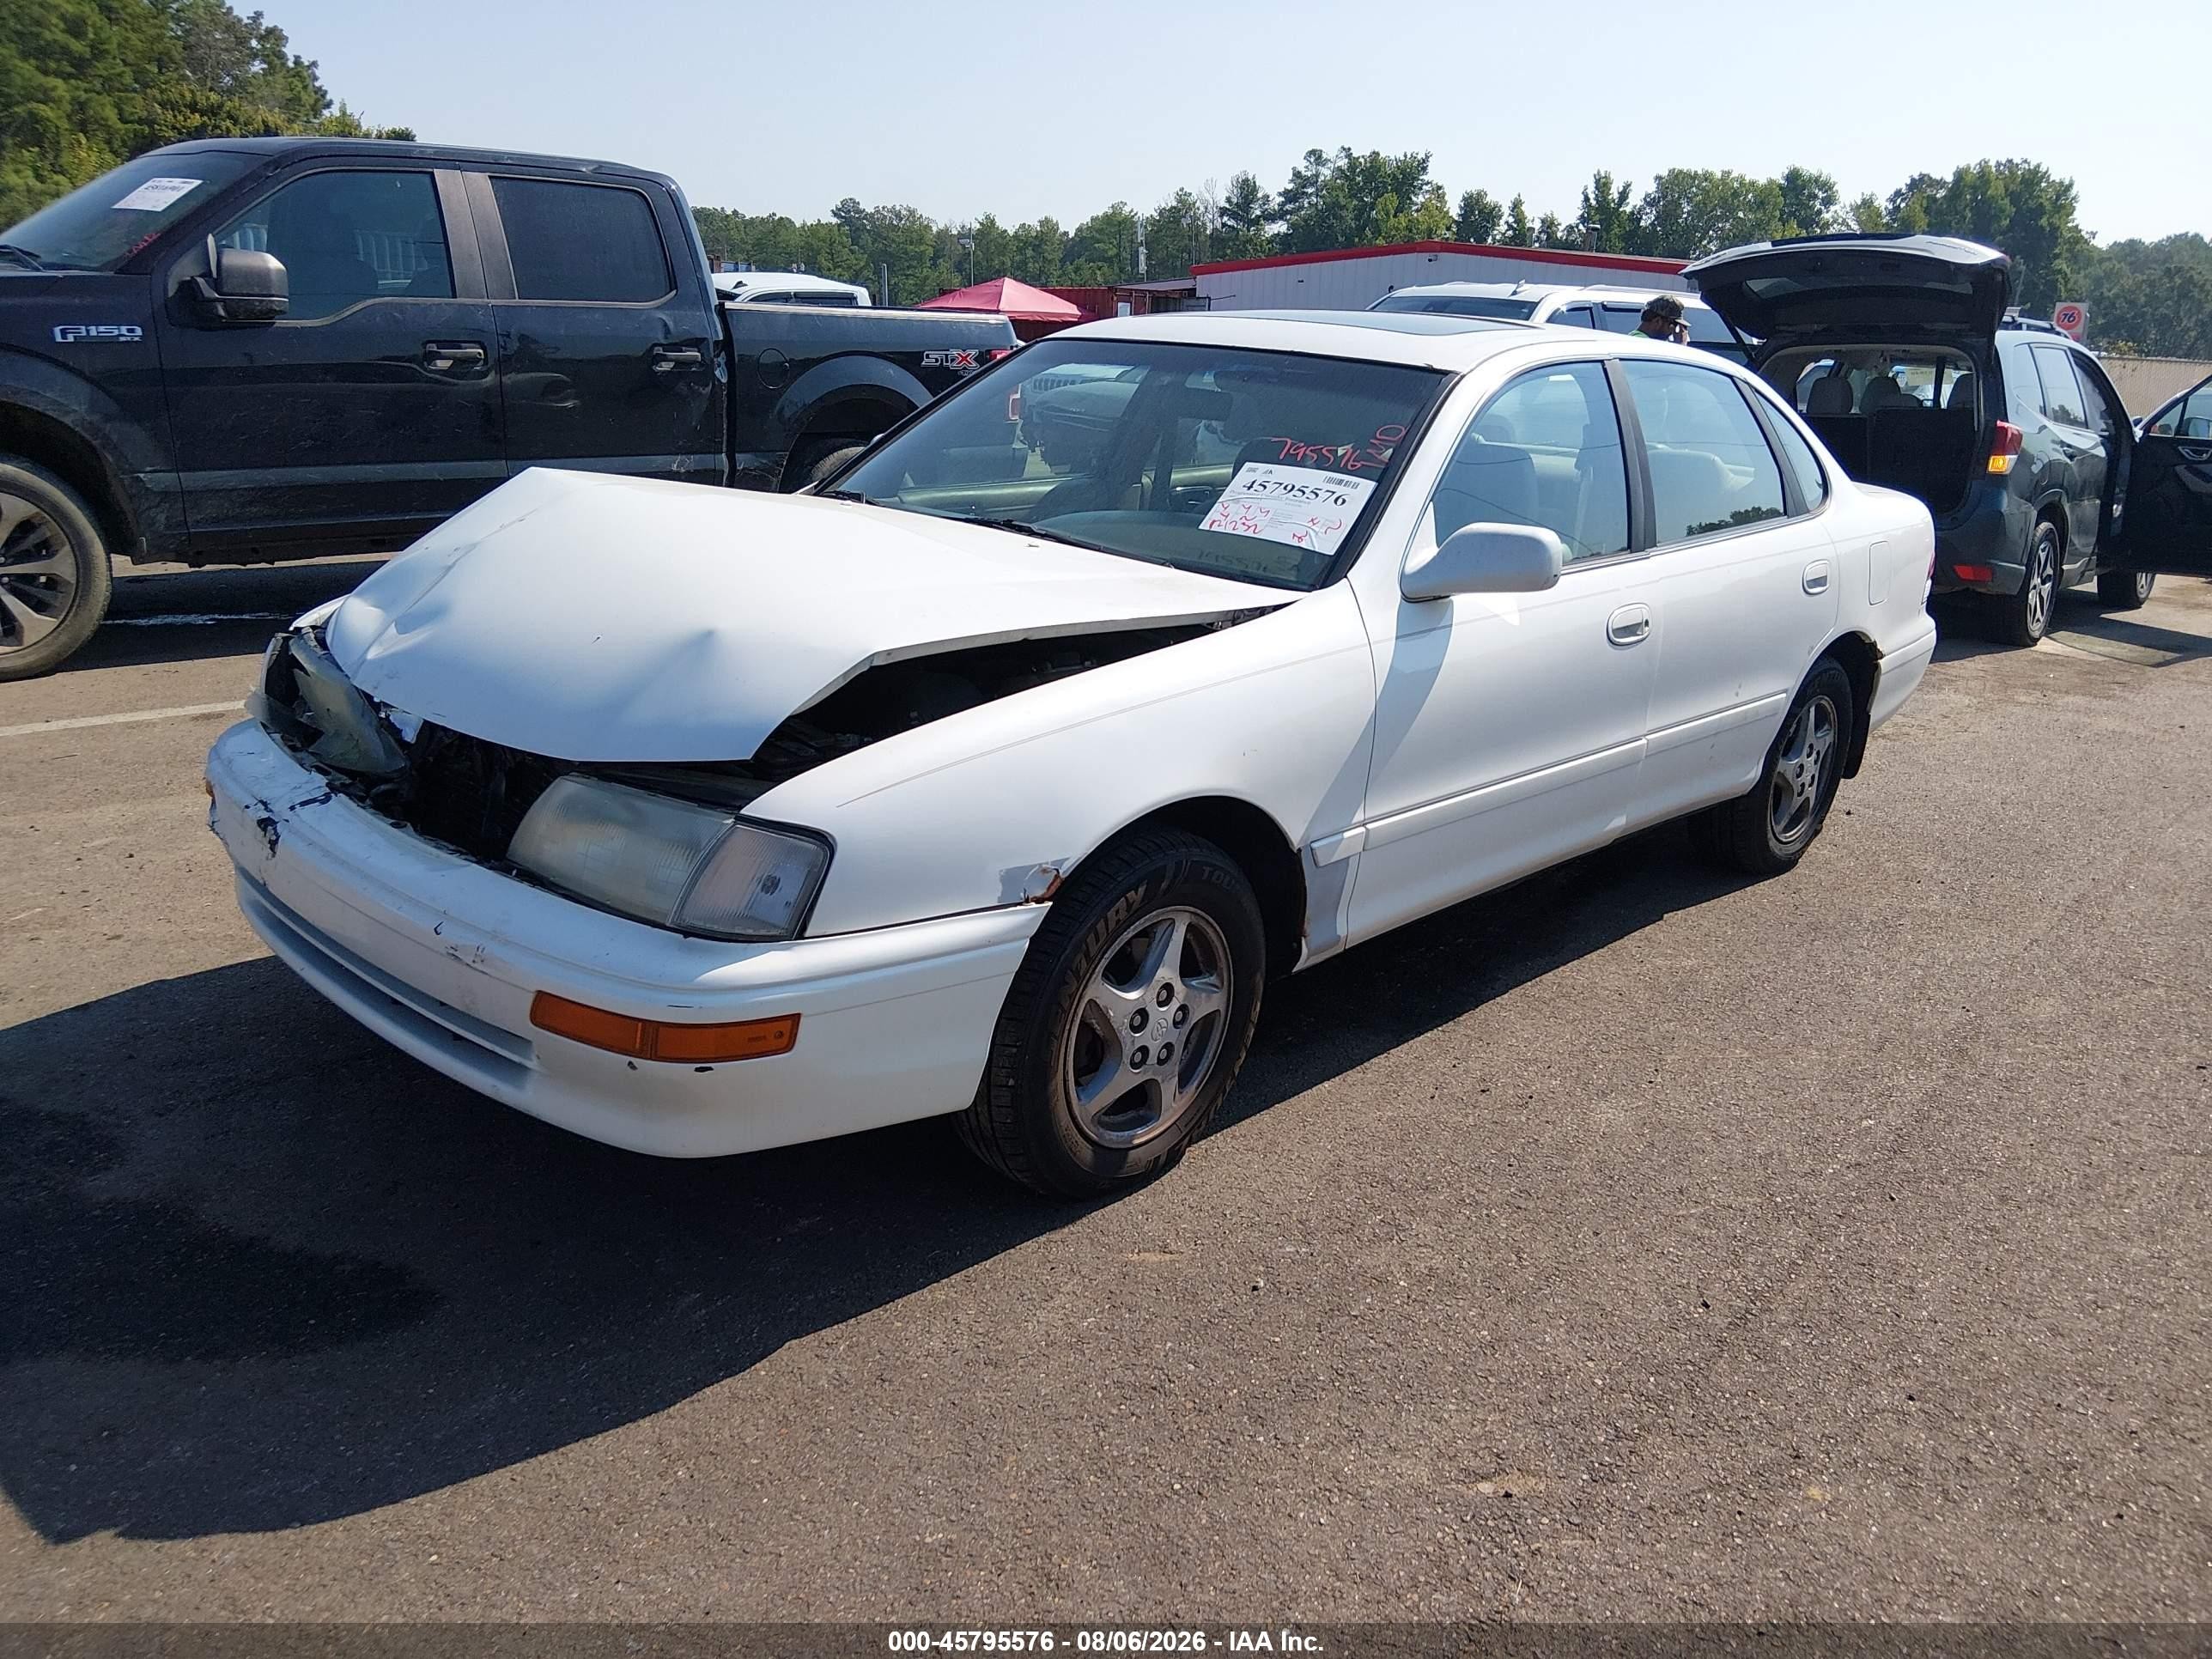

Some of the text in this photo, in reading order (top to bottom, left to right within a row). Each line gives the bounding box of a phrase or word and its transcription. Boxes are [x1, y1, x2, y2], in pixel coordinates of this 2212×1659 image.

[2061, 311, 2076, 323] 76
[921, 349, 980, 369] STX
[1243, 479, 1349, 507] 45795576
